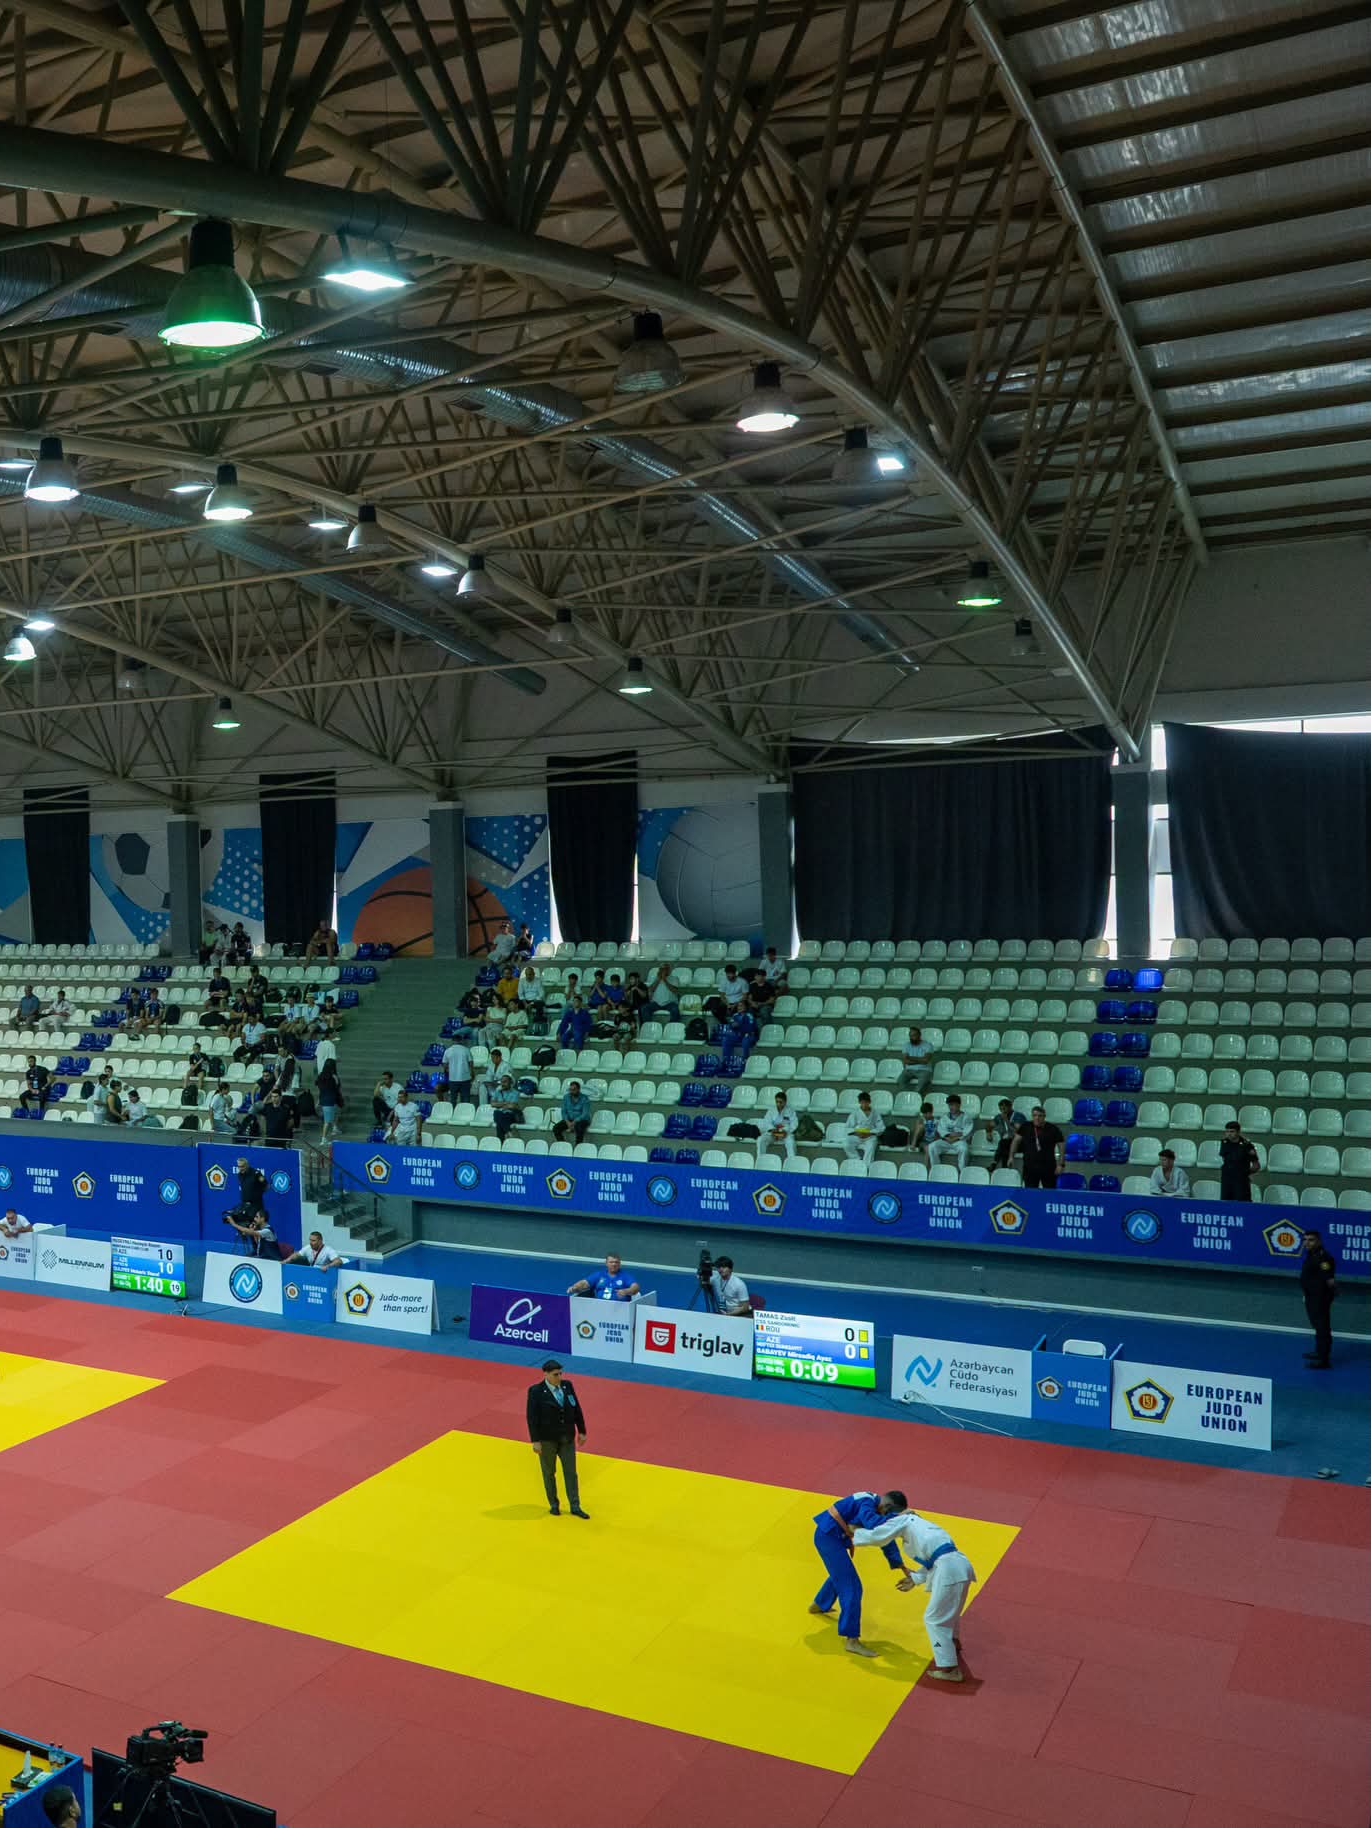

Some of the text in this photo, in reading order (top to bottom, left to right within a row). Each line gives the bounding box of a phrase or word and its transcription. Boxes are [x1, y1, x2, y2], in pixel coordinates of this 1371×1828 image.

[403, 1157, 441, 1168] EUROPEAN
[413, 1168, 432, 1176] JUDO
[492, 1164, 533, 1175] EUROPEAN
[110, 1174, 144, 1184] EUROPEAN
[411, 1177, 434, 1186] UNION
[503, 1175, 523, 1184] JUDO
[589, 1171, 633, 1183] EUROPEAN
[118, 1184, 135, 1192] JUDO
[500, 1184, 526, 1194] UNION
[600, 1183, 622, 1192] JUDO
[690, 1178, 738, 1190] EUROPEAN
[117, 1193, 137, 1201] UNION
[598, 1192, 625, 1202] UNION
[703, 1190, 726, 1200] JUDO
[802, 1186, 852, 1199] EUROPEAN
[700, 1200, 729, 1210] UNION
[815, 1198, 839, 1209] JUDO
[918, 1194, 972, 1208] EUROPEAN
[812, 1209, 842, 1220] UNION
[932, 1207, 958, 1218] JUDO
[1046, 1203, 1104, 1217] EUROPEAN
[930, 1218, 962, 1229] UNION
[1061, 1216, 1089, 1228] JUDO
[1181, 1212, 1243, 1227] EUROPEAN
[1057, 1227, 1093, 1239] UNION
[1197, 1226, 1227, 1238] JUDO
[1193, 1238, 1232, 1250] UNION
[158, 1249, 172, 1260] 10
[58, 1258, 104, 1269] MILLENNIUM
[159, 1262, 173, 1274] 10
[134, 1276, 163, 1293] 1:40
[172, 1284, 180, 1292] 19
[380, 1293, 422, 1302] Judo-more
[383, 1304, 428, 1314] than sport!
[494, 1323, 548, 1343] Azercell
[845, 1328, 854, 1342] 0
[681, 1332, 744, 1357] triglav
[766, 1336, 780, 1344] AZE
[844, 1344, 856, 1359] 0
[790, 1360, 838, 1381] 0:09
[950, 1358, 1014, 1375] Azərbaycan
[950, 1370, 979, 1381] Cüdo
[949, 1380, 1017, 1397] Federasiyası
[1187, 1384, 1262, 1405] EUROPEAN
[1206, 1401, 1242, 1417] JUDO
[1201, 1416, 1247, 1433] UNION
